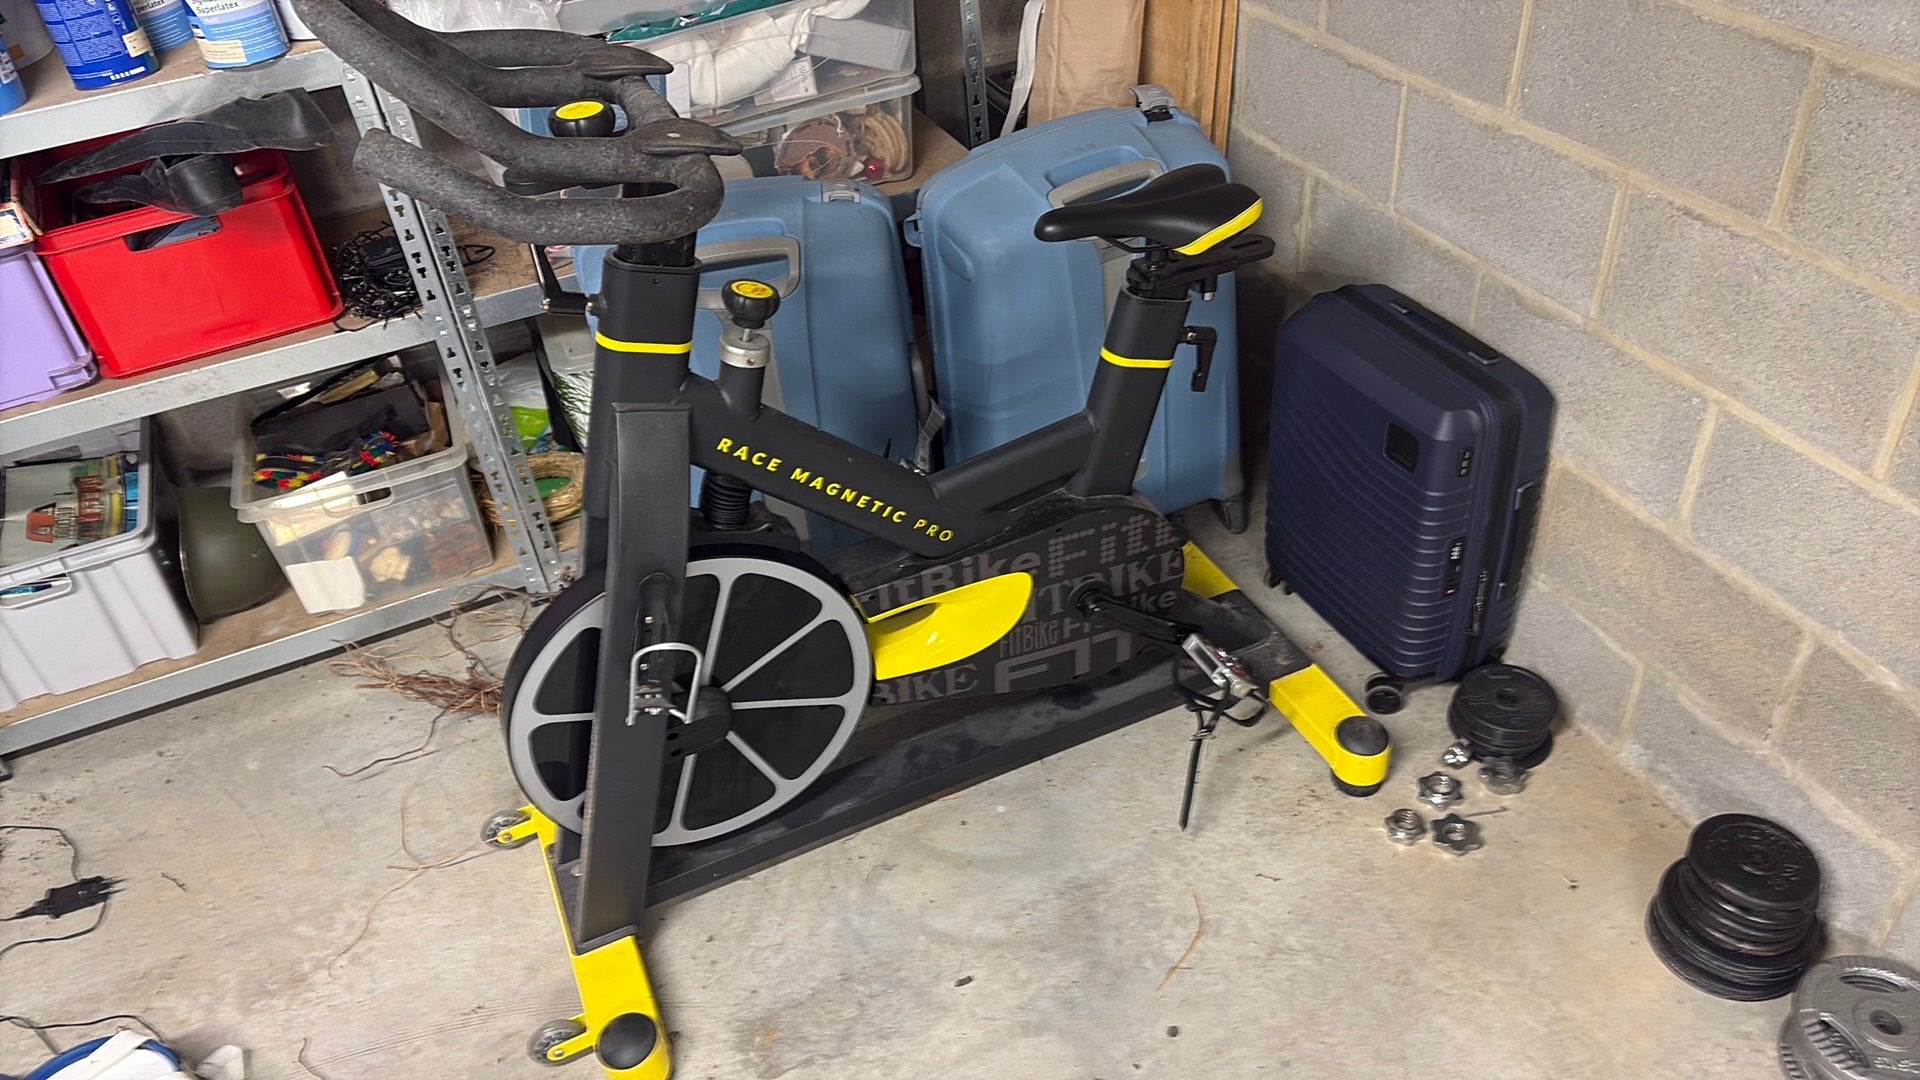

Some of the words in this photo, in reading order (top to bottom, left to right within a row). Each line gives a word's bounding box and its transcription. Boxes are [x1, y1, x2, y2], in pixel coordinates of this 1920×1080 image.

[196, 1, 240, 15] Superlatex
[716, 437, 784, 472] RACE
[790, 467, 908, 523] MAGNETIC
[913, 518, 954, 542] PRO
